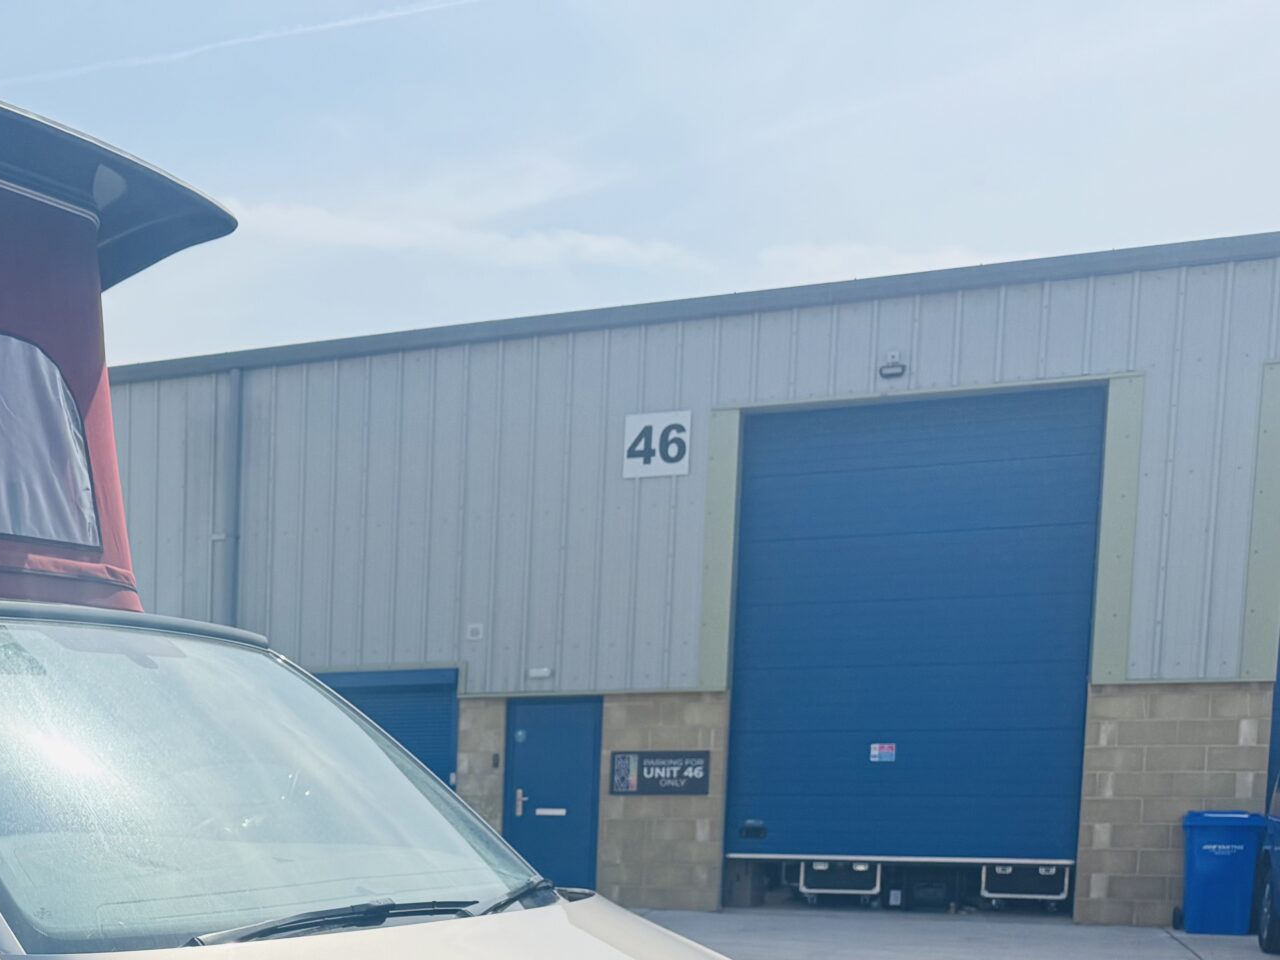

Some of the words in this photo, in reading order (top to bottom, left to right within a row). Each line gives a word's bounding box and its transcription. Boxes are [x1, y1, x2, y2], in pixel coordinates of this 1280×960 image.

[626, 423, 687, 465] 46
[643, 767, 680, 778] UNIT
[683, 766, 704, 779] 46
[660, 779, 686, 788] ONLY
